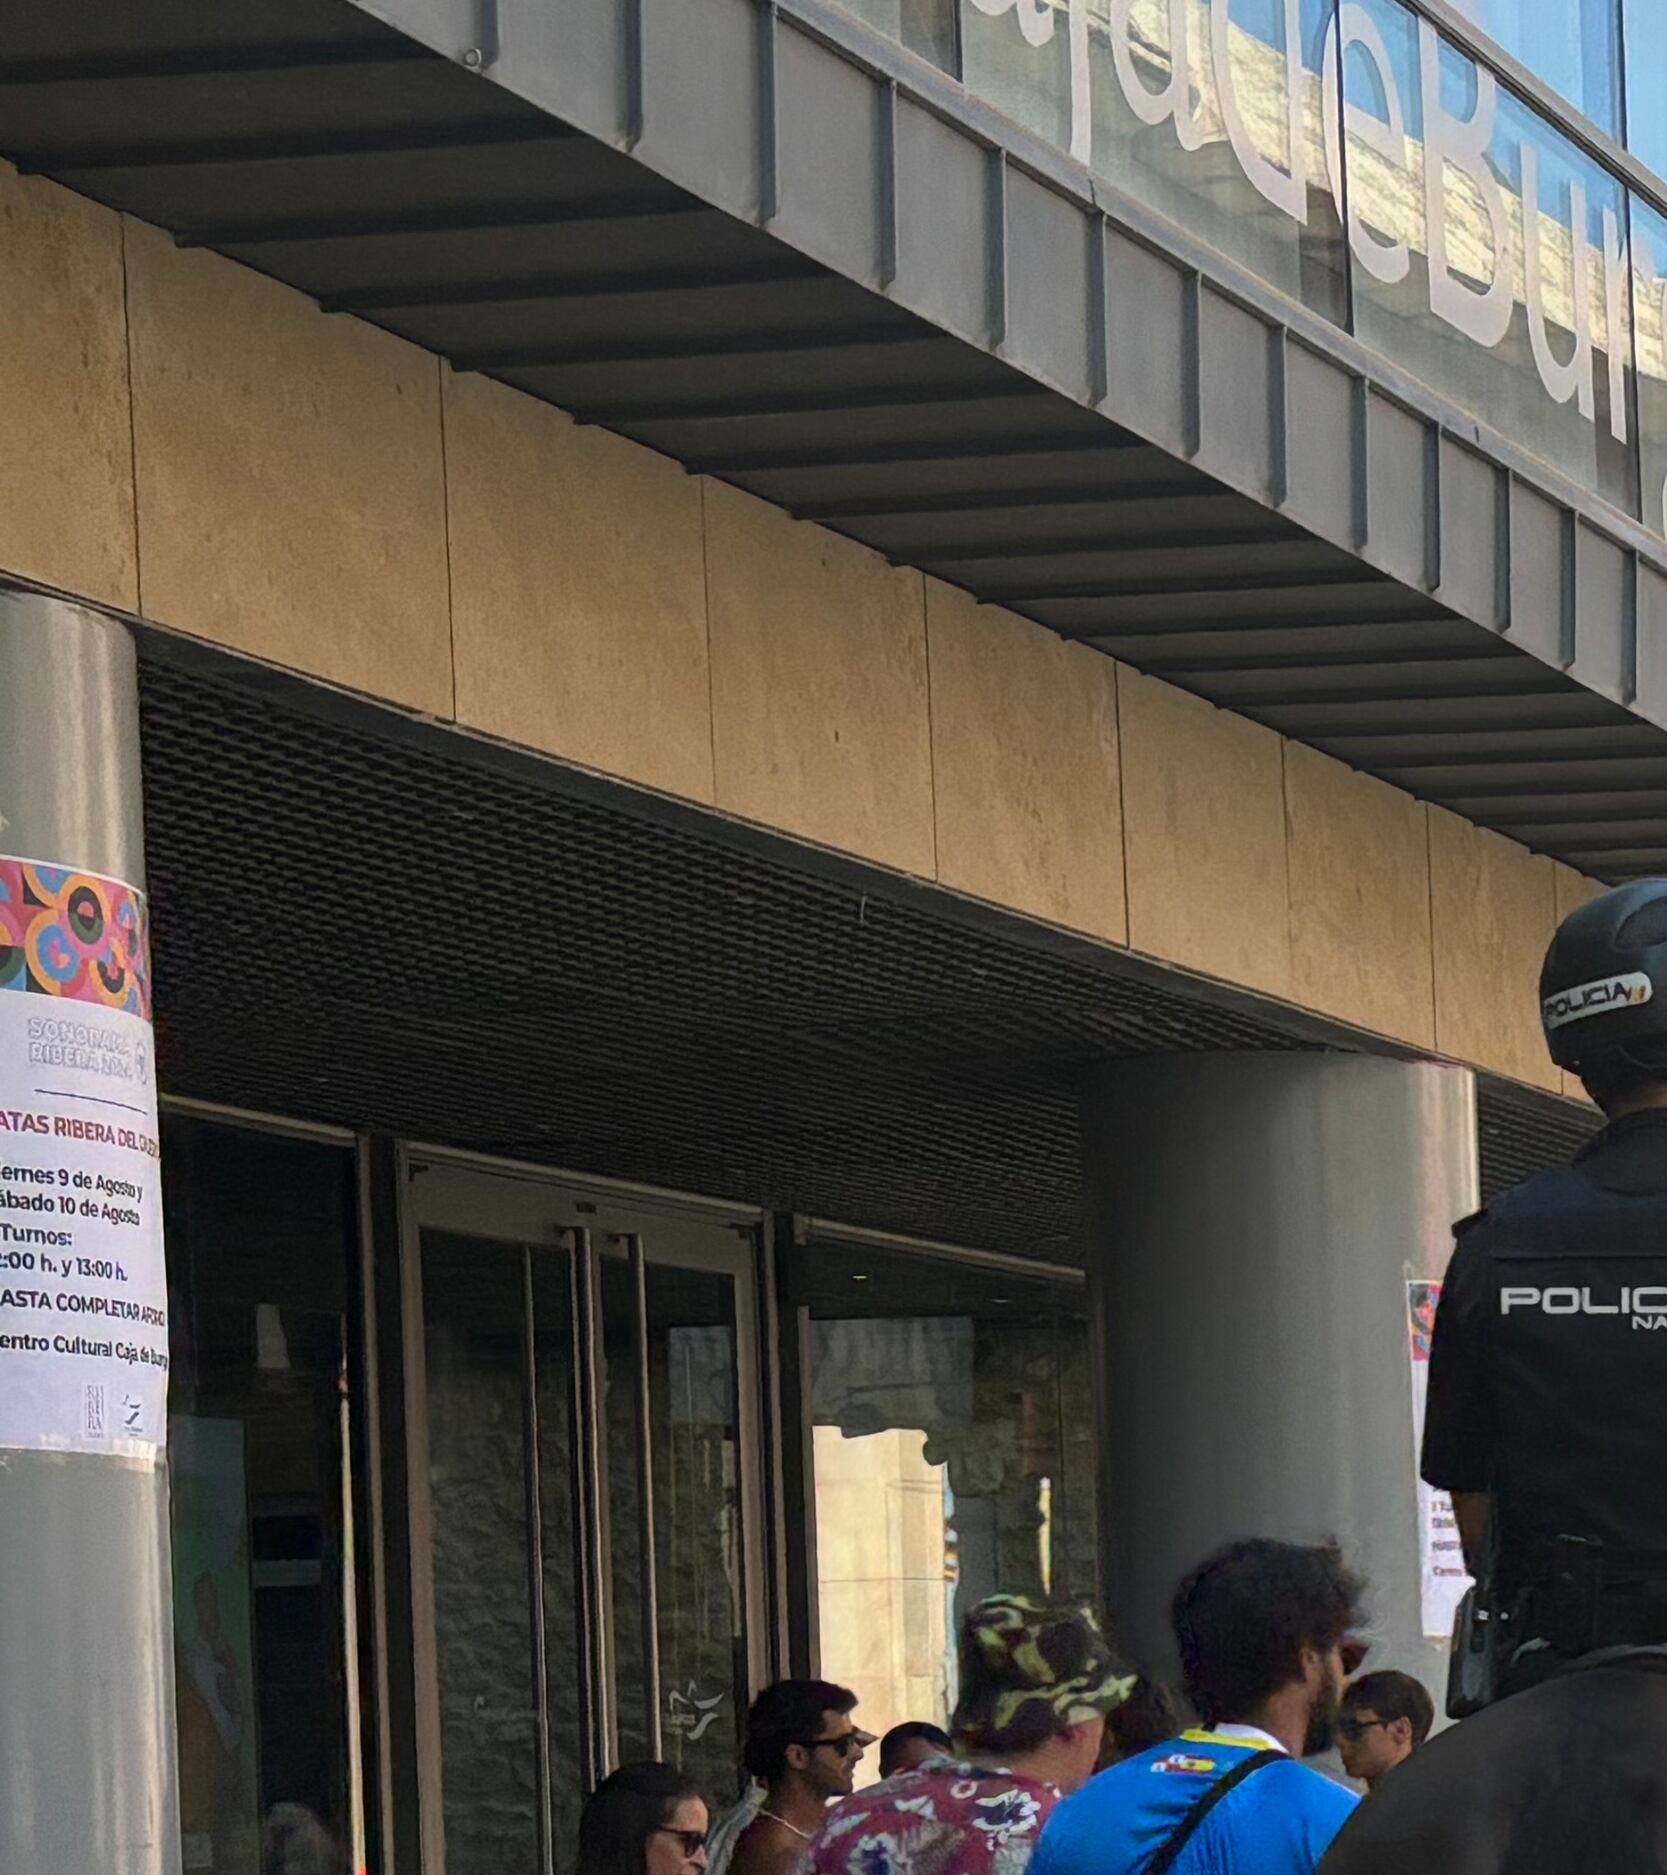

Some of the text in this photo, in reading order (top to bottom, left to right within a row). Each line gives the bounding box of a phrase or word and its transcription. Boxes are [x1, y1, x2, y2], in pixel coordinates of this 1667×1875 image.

[54, 1116, 116, 1146] RIBERA
[118, 1127, 139, 1151] DEL
[58, 1168, 69, 1187] 9
[72, 1171, 92, 1190] de
[96, 1174, 136, 1199] Agosto
[58, 1195, 75, 1215] 10
[79, 1199, 98, 1218] de
[101, 1203, 140, 1226] Agosto
[0, 1222, 73, 1247] Turnos:
[40, 1252, 58, 1274] h.
[61, 1258, 73, 1278] y
[75, 1256, 112, 1280] 13:00
[56, 1292, 140, 1322] COMPLETAR
[53, 1334, 113, 1358] Cultural
[115, 1342, 139, 1366] Caja
